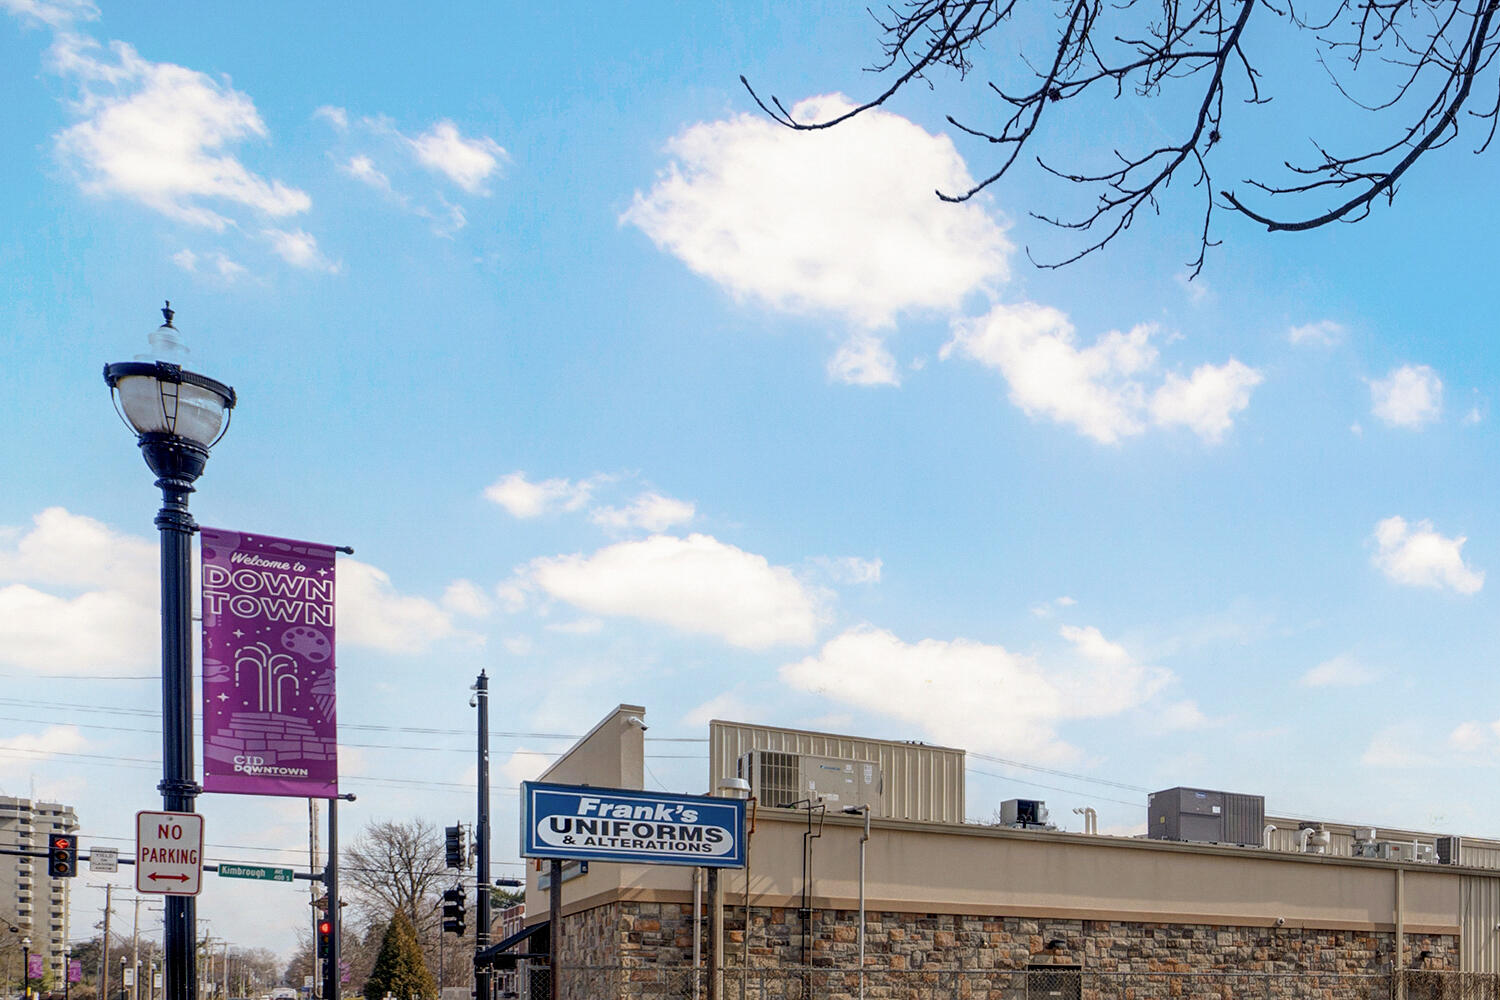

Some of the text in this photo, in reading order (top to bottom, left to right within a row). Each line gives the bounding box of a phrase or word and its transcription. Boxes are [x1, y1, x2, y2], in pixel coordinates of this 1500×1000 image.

[231, 552, 306, 572] Welcome to
[203, 564, 333, 602] DOWN
[203, 590, 333, 627] TOWN
[234, 755, 264, 766] CID
[234, 765, 308, 776] DOWNTOWN
[577, 797, 699, 823] Frank's
[158, 824, 182, 840] NO
[549, 817, 724, 843] UNIFORMS
[562, 835, 713, 853] & ALTERATIONS
[142, 847, 197, 865] PARKING
[221, 866, 266, 879] Kimbrough
